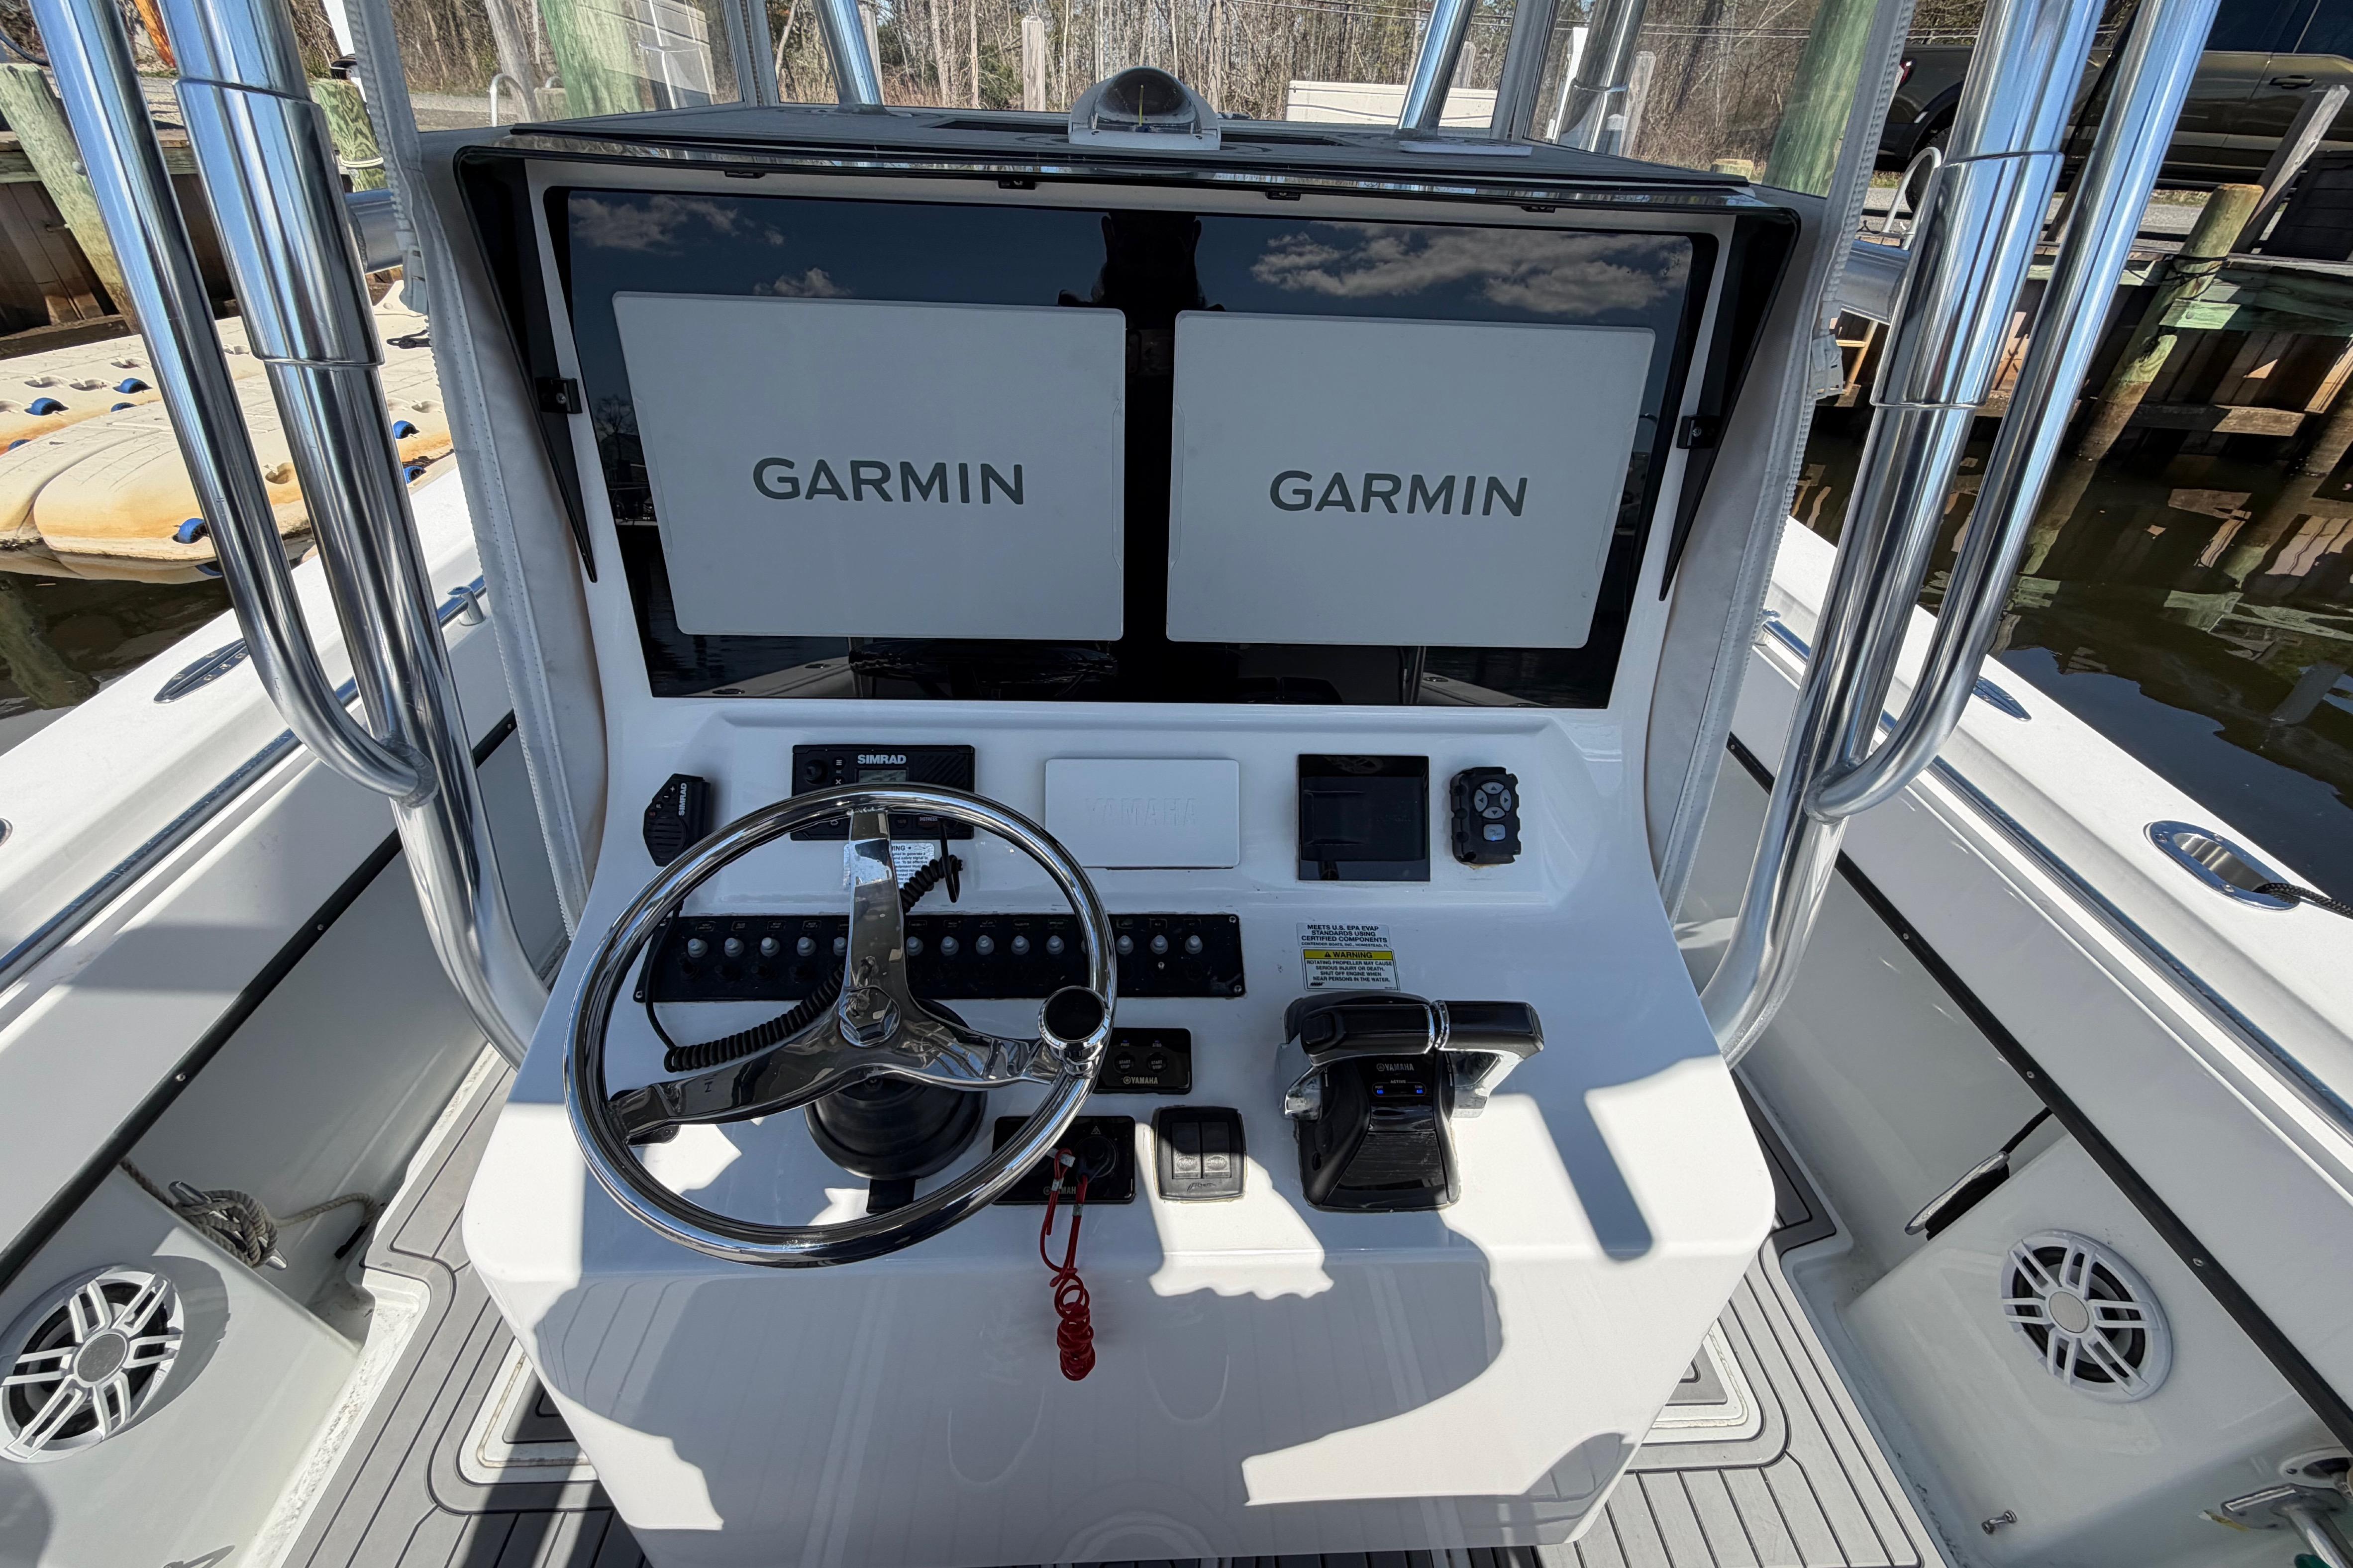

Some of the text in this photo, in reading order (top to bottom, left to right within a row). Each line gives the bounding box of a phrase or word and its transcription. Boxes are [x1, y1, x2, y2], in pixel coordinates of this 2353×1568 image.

[753, 457, 1023, 505] GARMIN
[1270, 471, 1528, 517] GARMIN
[857, 754, 907, 764] SIMRAD
[678, 783, 687, 816] SIMRAD
[1085, 798, 1198, 826] YAMAHA
